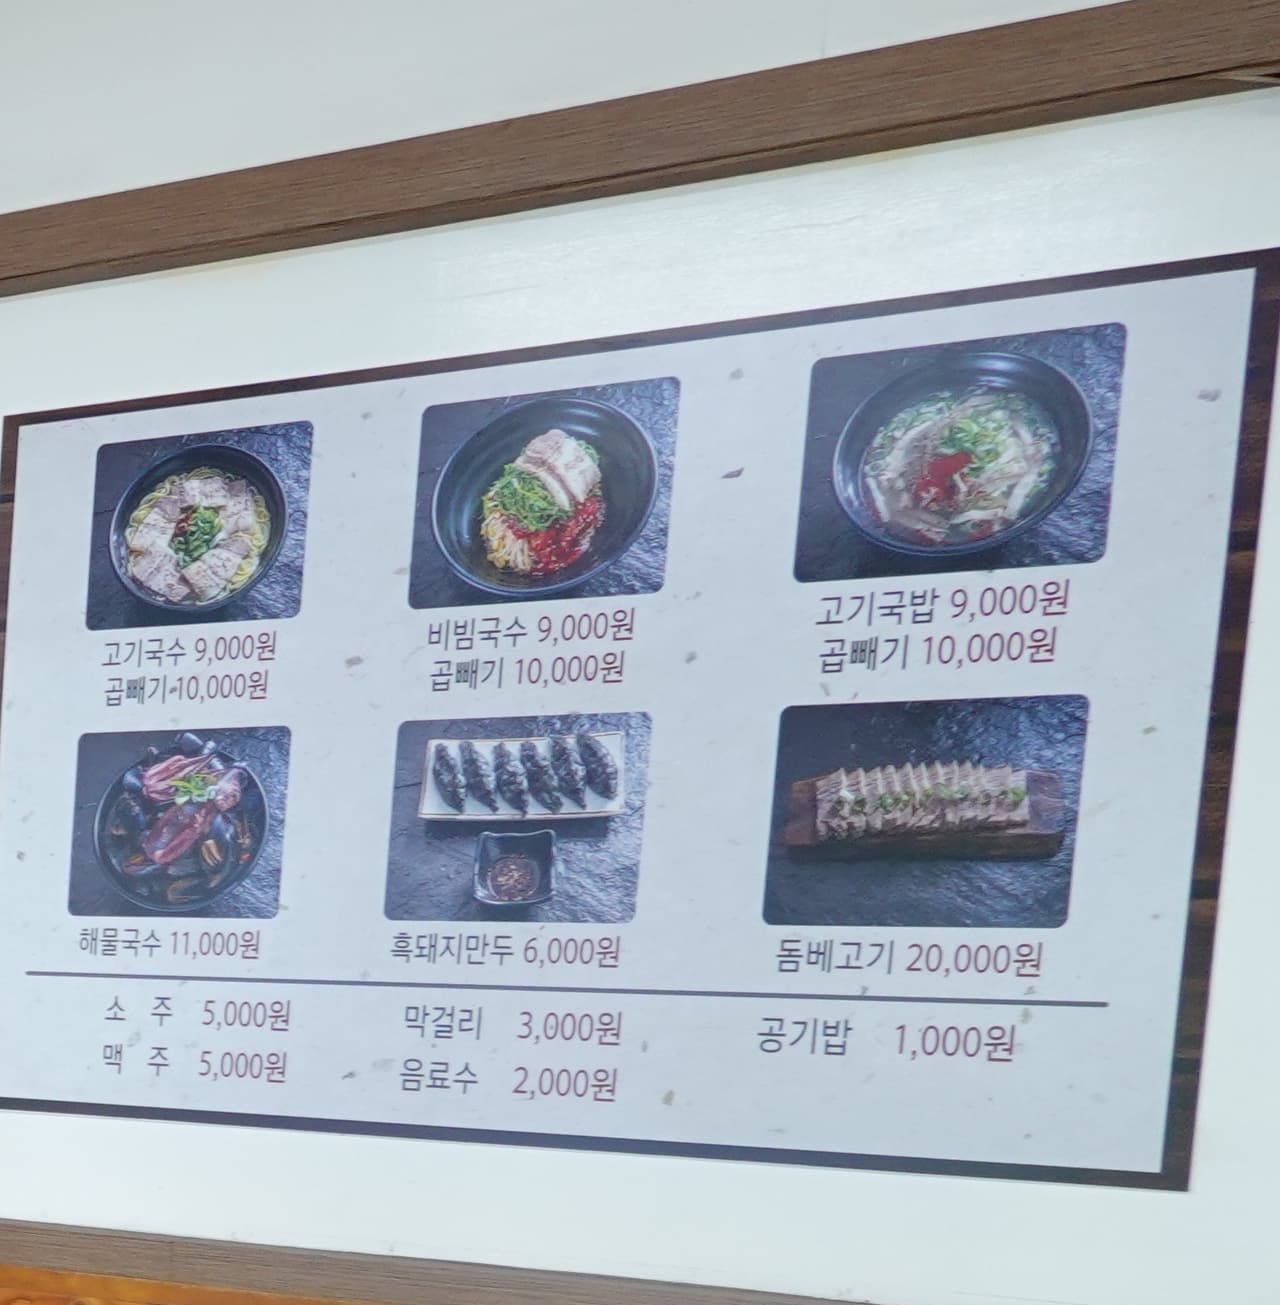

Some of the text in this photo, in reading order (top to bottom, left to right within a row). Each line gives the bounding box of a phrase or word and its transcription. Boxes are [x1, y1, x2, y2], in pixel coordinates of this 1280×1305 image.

[815, 579, 1070, 626] 고기국밥 9,000원
[102, 631, 276, 667] 고기국수 9,000원
[426, 608, 635, 651] 비빔국수 9,000원
[819, 626, 1057, 673] 곱빼기 10,000원
[105, 670, 268, 706] 곱빼기 10,000원
[430, 651, 624, 692] 곱빼기 10,000원
[80, 928, 260, 959] 해물국수 11,000원
[390, 933, 620, 969] 흑돼지만두 6,000원
[776, 939, 1043, 978] 돔베고기 20,000원
[151, 997, 172, 1027] 주
[202, 1000, 290, 1031] 5,000원
[405, 1005, 622, 1046] 막걸리 3,000원
[757, 1018, 1017, 1062] 공기밥 1,000원
[148, 1047, 169, 1076] 주
[199, 1051, 286, 1083] 5,000원
[400, 1059, 617, 1102] 음료수 2,000원
